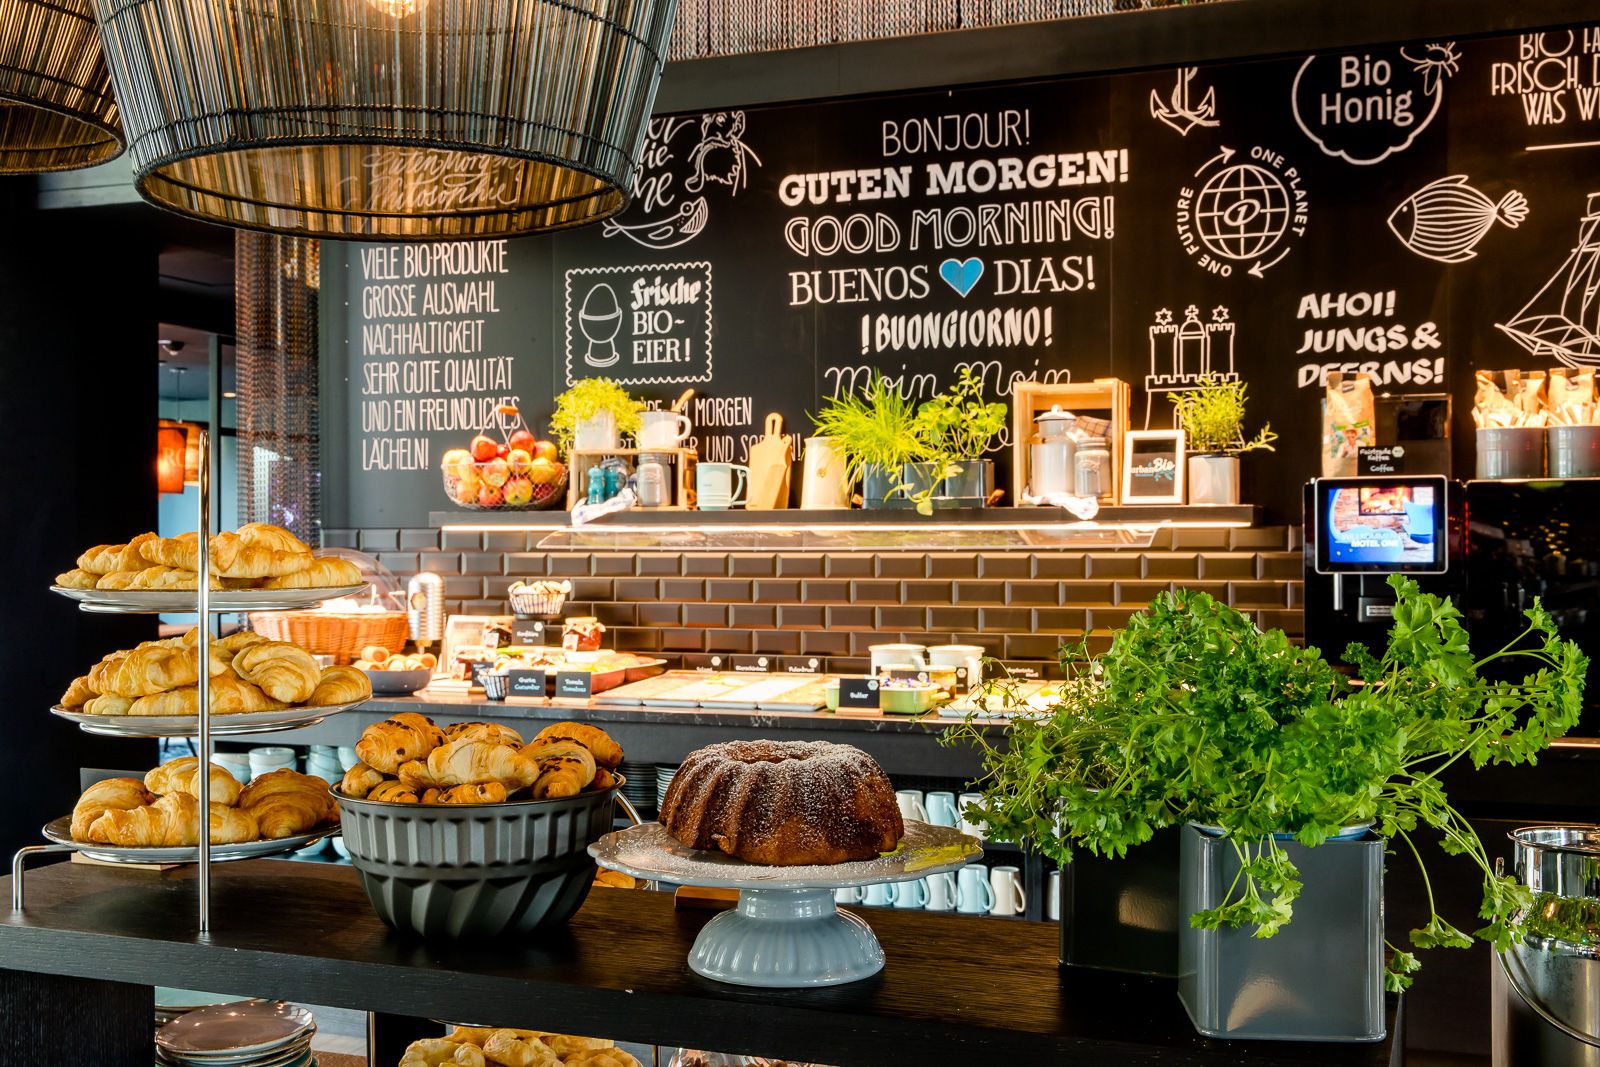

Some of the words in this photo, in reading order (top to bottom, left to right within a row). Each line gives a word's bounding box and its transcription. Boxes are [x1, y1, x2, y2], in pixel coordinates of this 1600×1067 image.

[1520, 30, 1574, 61] BIO
[1341, 55, 1391, 88] Bio
[1321, 88, 1414, 127] Honig
[1521, 90, 1566, 126] WAS
[882, 109, 1030, 156] BONJOUR!
[779, 166, 912, 206] GUTEN
[926, 149, 1129, 196] MORGEN!
[1251, 146, 1285, 169] ONE
[1284, 167, 1309, 237] PLANET
[785, 213, 900, 257] GOOD
[910, 196, 1115, 250] MORNING!
[1176, 187, 1200, 255] FUTURE
[361, 247, 400, 280] VIELE
[788, 265, 930, 305] BUENOS
[993, 255, 1096, 296] DIAS!
[1197, 254, 1232, 277] ONE
[363, 284, 417, 319] GROSSE
[423, 280, 500, 316] AUSWAHL
[1297, 290, 1396, 319] AHOI!
[363, 320, 485, 356] NACHHALTIGKEIT
[1296, 324, 1409, 353] JUNGS
[1411, 321, 1442, 350] &
[362, 361, 400, 395] SEHR
[403, 360, 441, 394] GUTE
[444, 356, 514, 392] QUALITÄT
[824, 364, 943, 401] Moin
[954, 359, 1071, 397] Moin
[362, 400, 391, 432] UND
[394, 399, 416, 432] EIN
[420, 396, 521, 432] FREUNDLICHES
[695, 396, 752, 427] MORGEN
[362, 437, 429, 471] LÄCHELN!
[706, 435, 734, 463] UND
